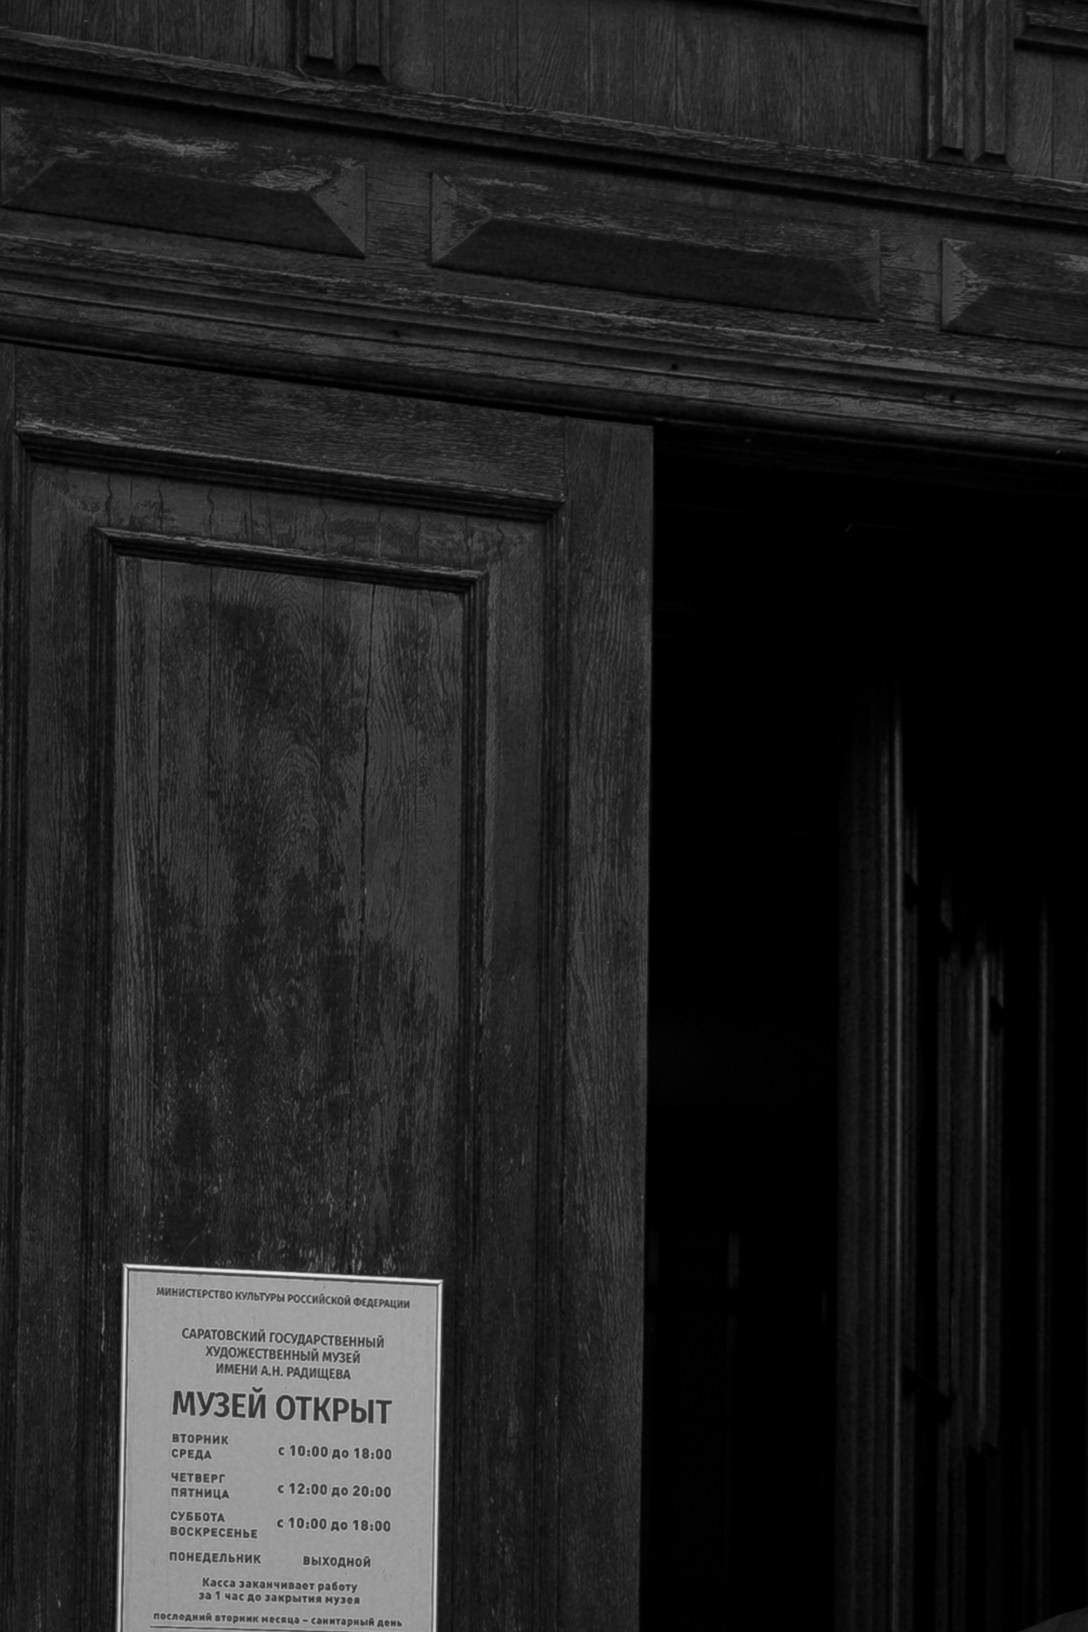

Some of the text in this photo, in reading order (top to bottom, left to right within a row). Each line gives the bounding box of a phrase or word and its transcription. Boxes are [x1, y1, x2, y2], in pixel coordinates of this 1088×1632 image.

[156, 1287, 410, 1309] МИНИСТЕРСТВО КУЛЬТУРЫ РОССИЙСКОЙ ФЕДЕРАЦИИ
[182, 1327, 384, 1348] САРАТОВСКИЙ ГОСУДАРСТВЕННЫЙ
[205, 1346, 360, 1364] ХУДОЖЕСТВЕННЫЙ МУЗЕЙ
[216, 1363, 351, 1380] ИМЕНИ А.Н. РАДИЩЕВА
[172, 1386, 392, 1424] МУЗЕЙ ОТКРЫТ
[172, 1434, 229, 1445] ВТОРНИК
[172, 1449, 212, 1461] СРЕДА
[278, 1445, 392, 1461] с 10:00 до 18:00
[171, 1472, 225, 1483] ЧЕТВЕРГ
[171, 1488, 229, 1500] ПЯТНИЦА
[278, 1483, 392, 1498] с 12:00 до 20:00
[171, 1511, 225, 1523] СУББОТА
[277, 1517, 391, 1533] с 10:00 до 18:00
[170, 1526, 258, 1539] ВОСКРЕСЕНЬЕ
[169, 1552, 371, 1568] ПОНЕДЕЛЬНИК ВЫХОДНОЙ
[202, 1577, 358, 1593] Касса заканчивает работу
[199, 1591, 360, 1606] за 1 час до закрытия музея
[154, 1611, 212, 1622] последний
[215, 1614, 259, 1623] вторник
[261, 1616, 300, 1625] месяца
[311, 1616, 374, 1627] санитарный
[377, 1618, 403, 1628] день
